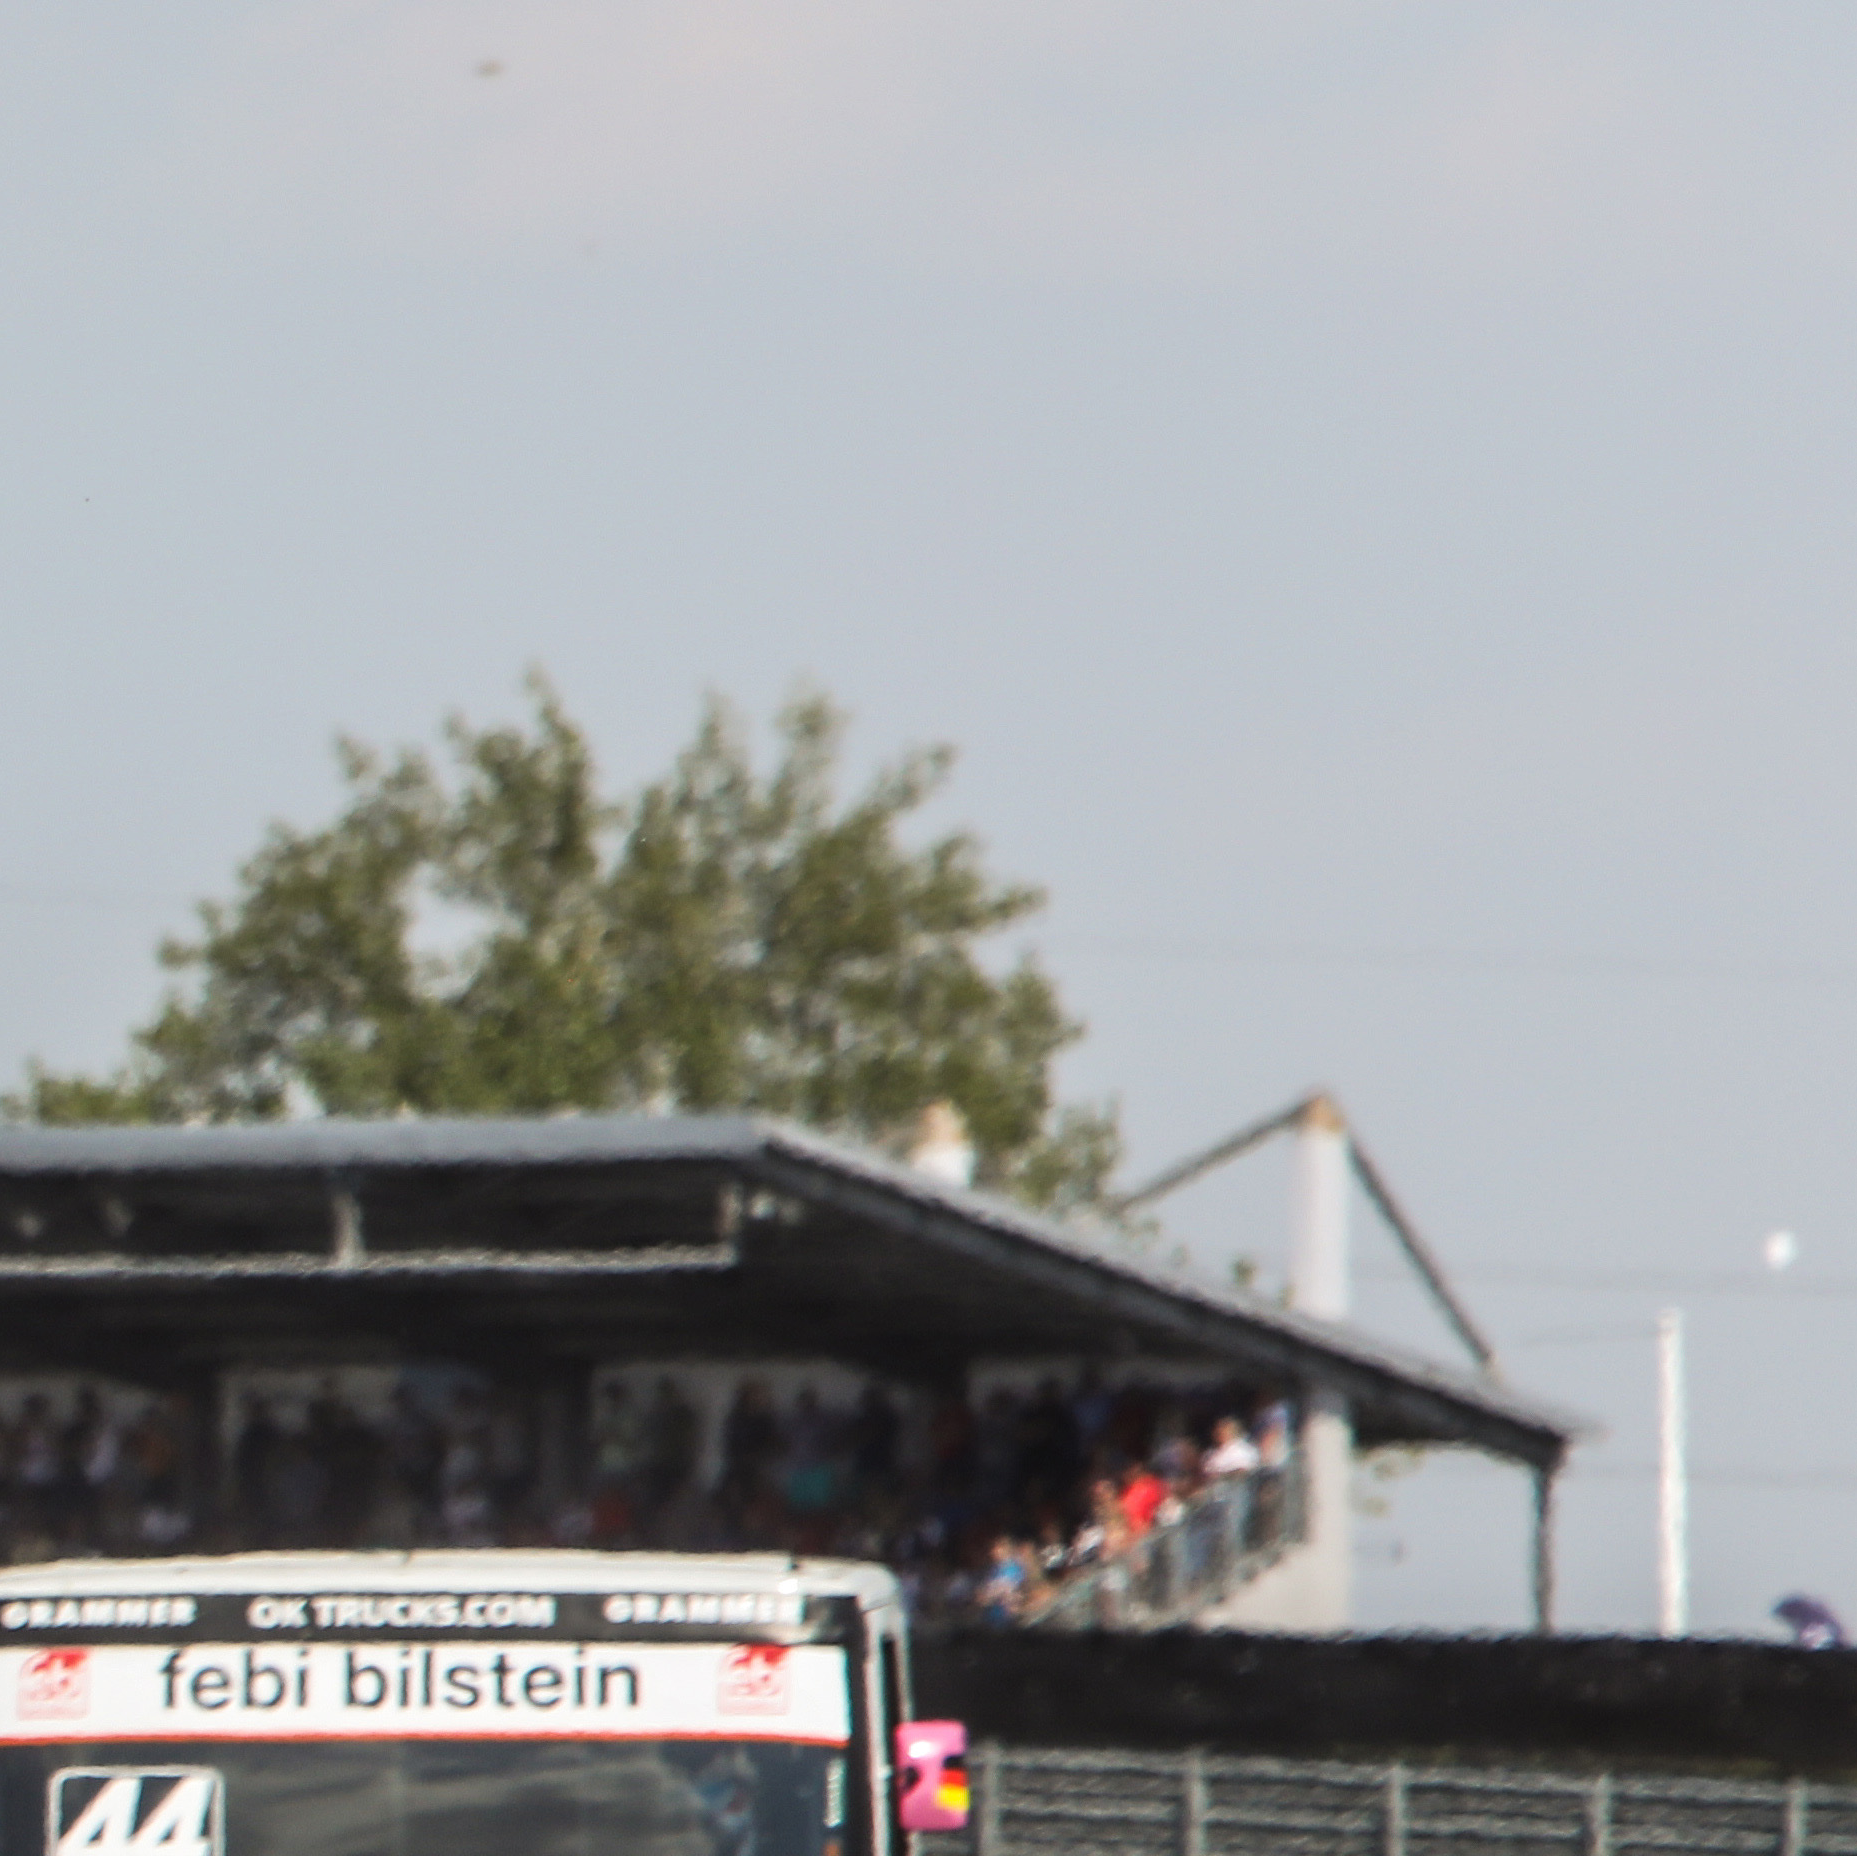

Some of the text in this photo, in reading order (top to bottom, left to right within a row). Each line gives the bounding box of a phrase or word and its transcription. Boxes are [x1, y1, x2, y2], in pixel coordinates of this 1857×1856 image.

[0, 1598, 199, 1632] GRAMMER
[245, 1598, 557, 1629] OK TRUCKS.COM
[159, 1646, 641, 1710] febi bilstein
